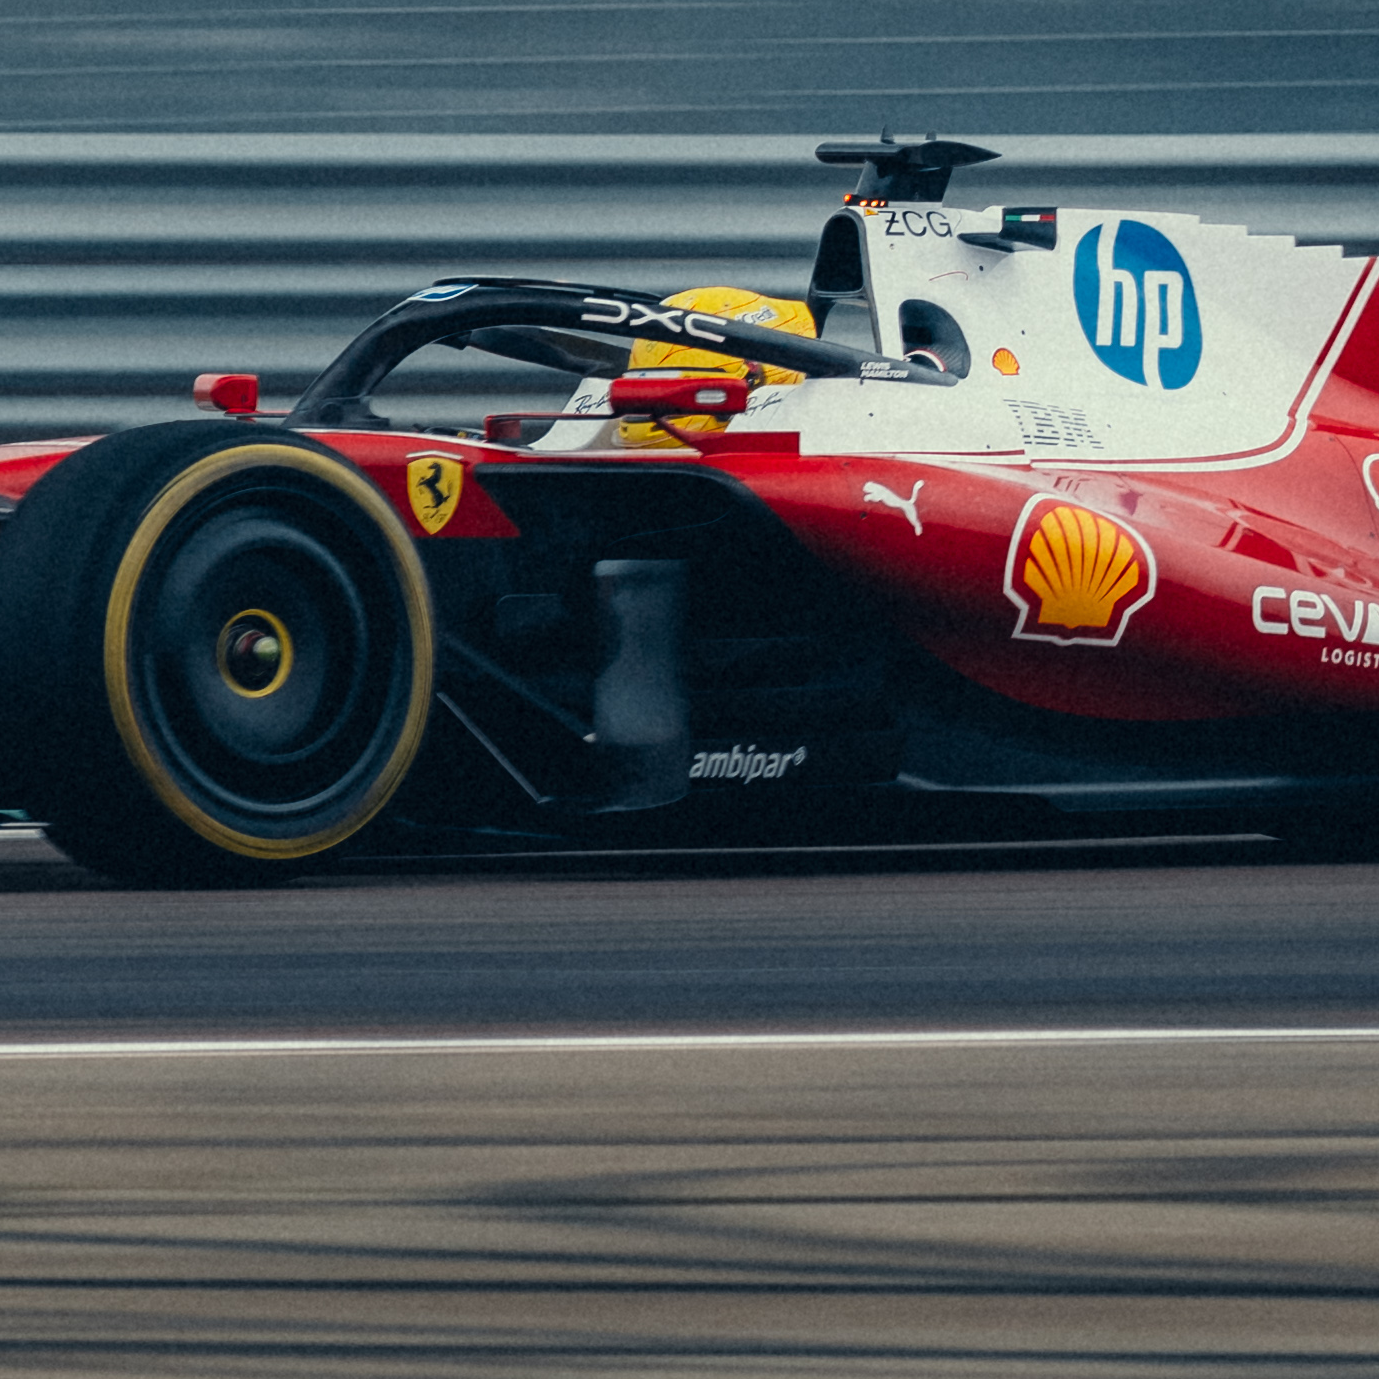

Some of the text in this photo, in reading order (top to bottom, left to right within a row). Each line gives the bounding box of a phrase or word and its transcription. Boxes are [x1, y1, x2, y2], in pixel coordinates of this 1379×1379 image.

[1095, 219, 1184, 390] hp
[1003, 399, 1105, 449] IBM
[688, 743, 794, 785] ambipar
